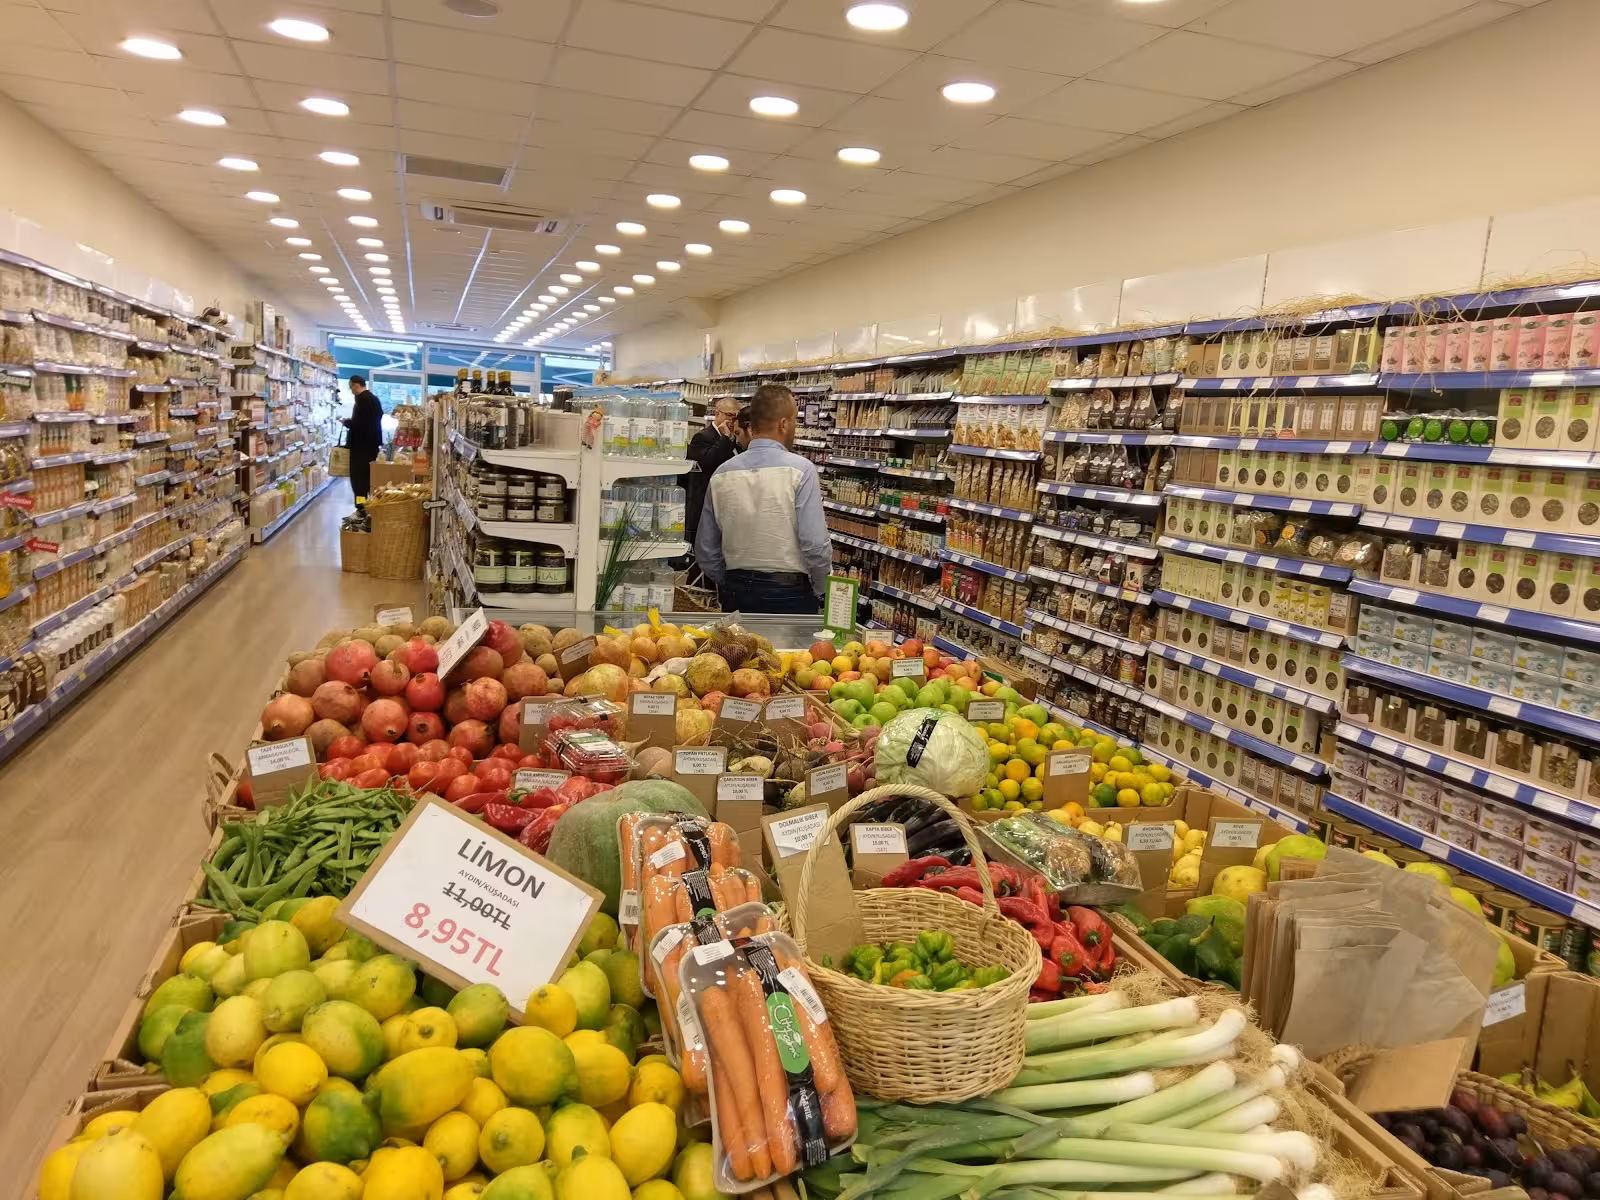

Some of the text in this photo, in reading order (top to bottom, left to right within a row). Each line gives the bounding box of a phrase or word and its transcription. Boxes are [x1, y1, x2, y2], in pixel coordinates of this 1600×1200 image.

[778, 813, 819, 829] DOLMALIK BİBER
[781, 821, 821, 836] AYDIN/KUŞADASI
[794, 834, 808, 842] 10,00
[457, 837, 546, 900] LİMON
[457, 868, 521, 908] AYDIN/KUŞADASI
[442, 880, 512, 931] 11,00TL
[403, 901, 505, 978] 8,95TL
